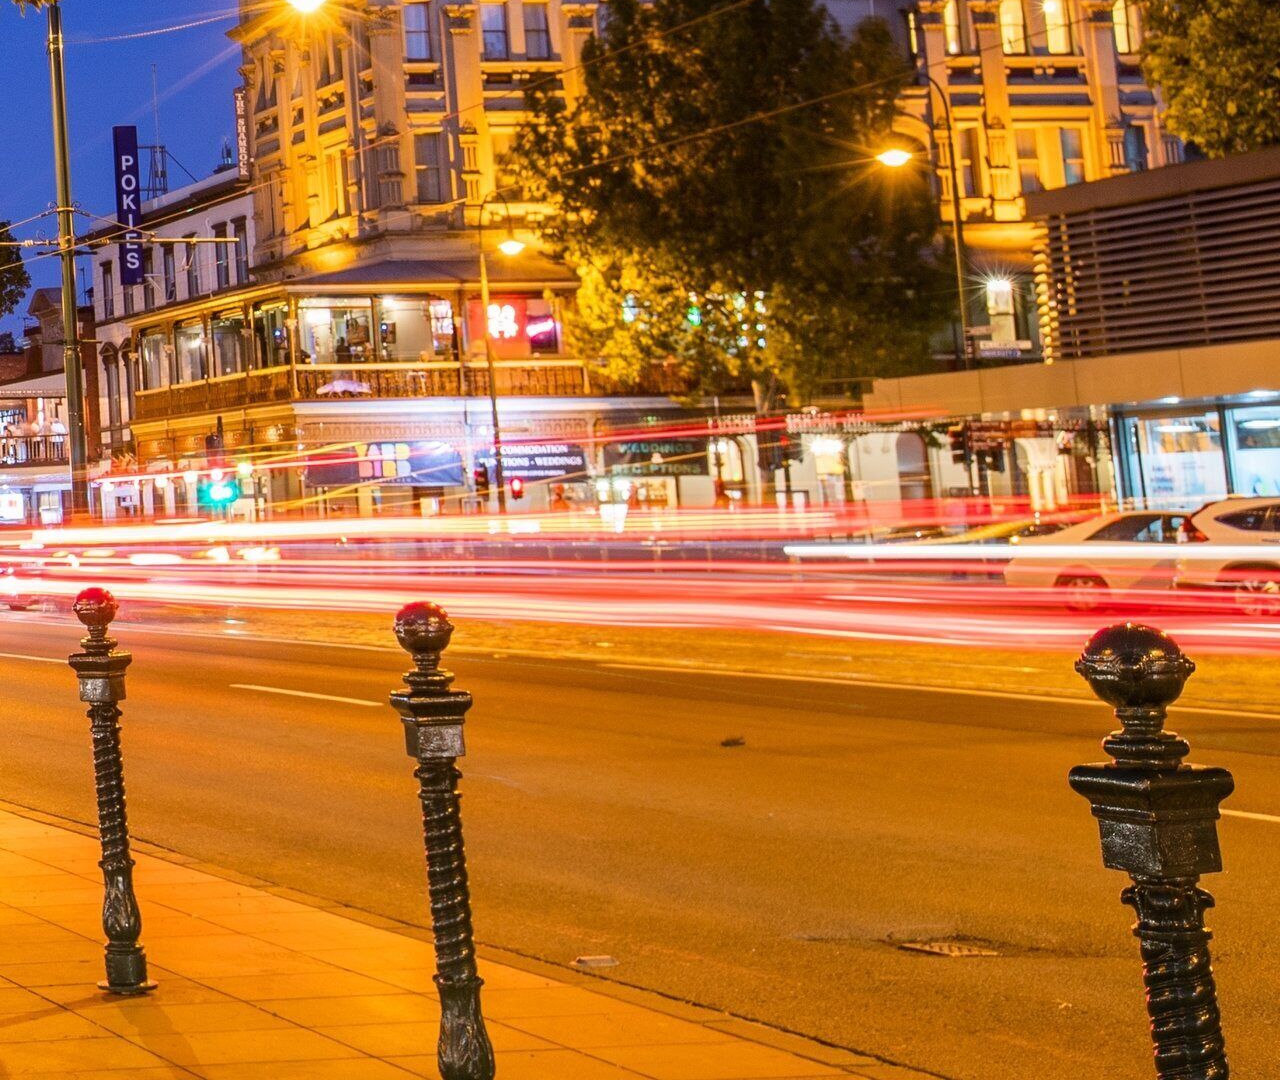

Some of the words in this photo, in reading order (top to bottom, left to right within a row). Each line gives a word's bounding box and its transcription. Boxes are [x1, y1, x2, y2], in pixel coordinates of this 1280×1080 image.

[235, 93, 245, 115] THE
[237, 118, 249, 175] SHAMROCK
[121, 155, 140, 269] POKIES
[355, 443, 411, 460] YARD
[618, 442, 693, 453] WEDDINGS
[535, 456, 583, 467] WEDDINGS
